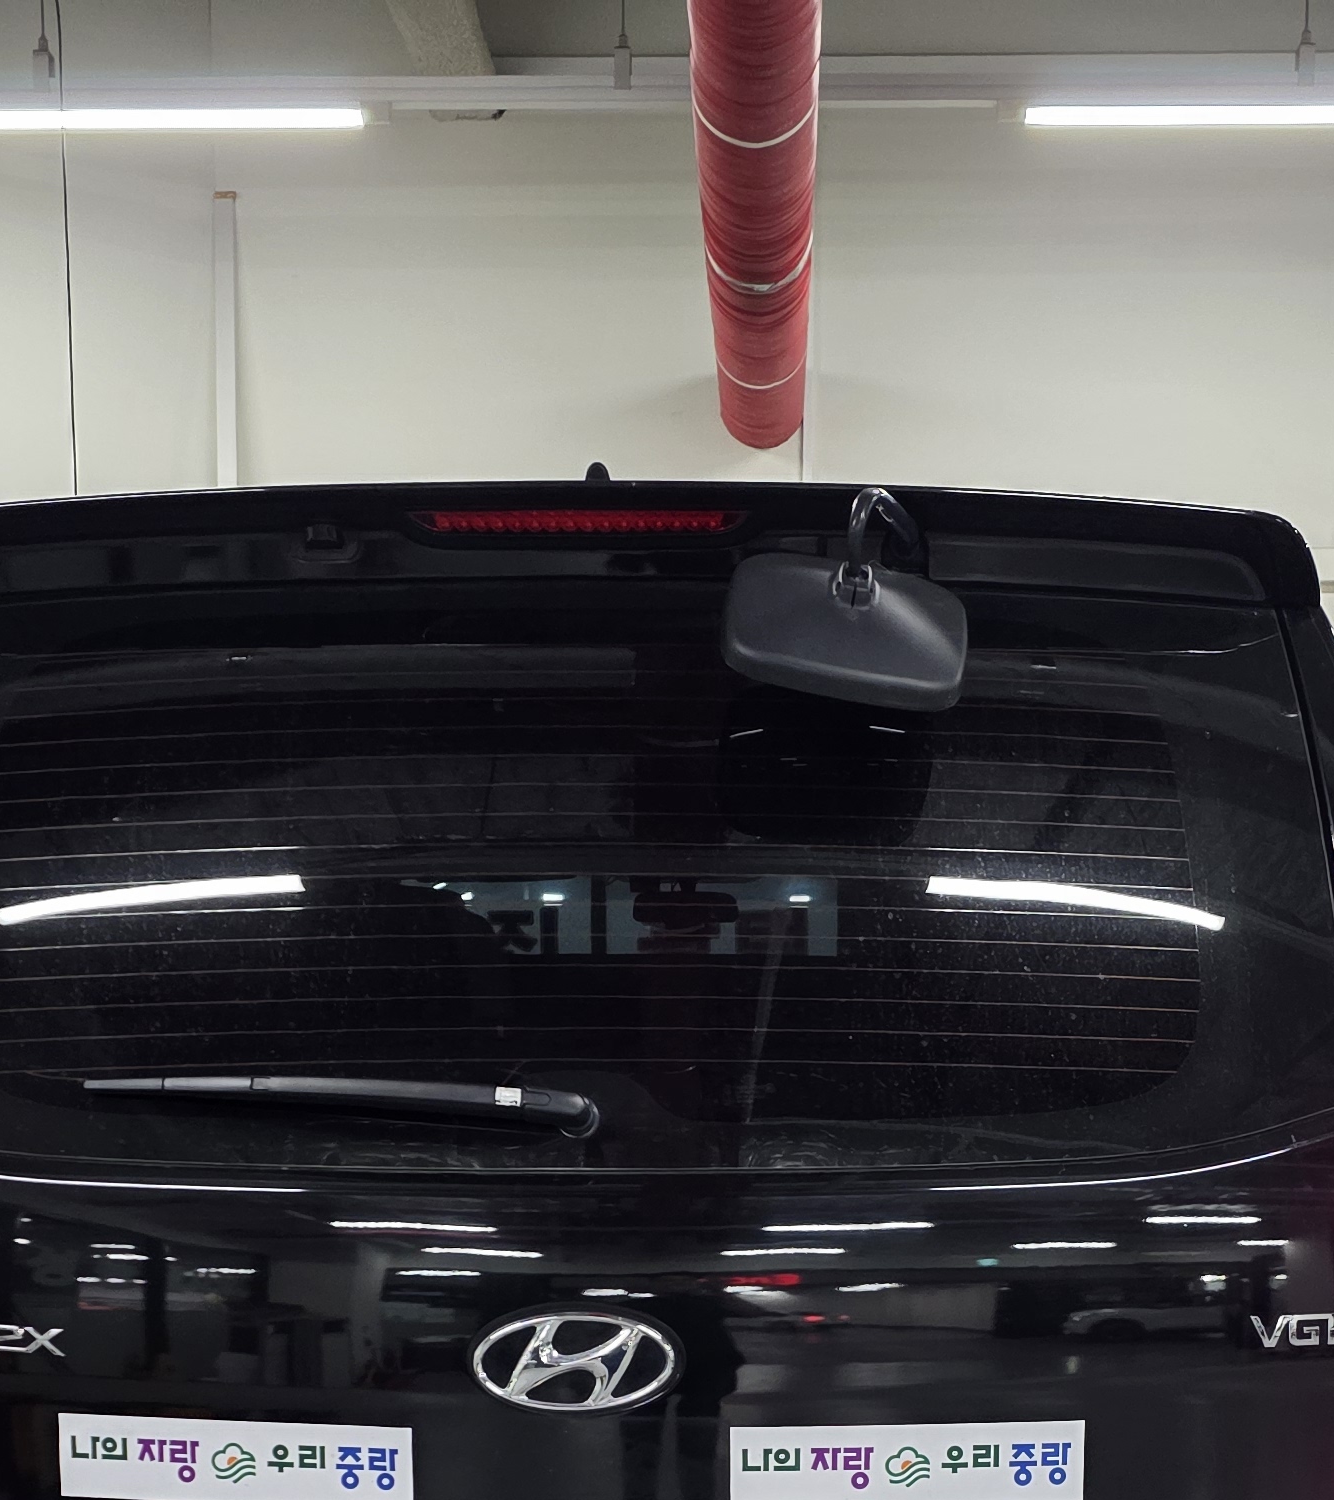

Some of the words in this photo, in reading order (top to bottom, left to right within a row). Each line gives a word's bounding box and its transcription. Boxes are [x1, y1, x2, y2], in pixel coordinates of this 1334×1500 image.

[71, 1435, 129, 1463] 나의
[137, 1438, 201, 1485] 자랑
[267, 1444, 328, 1474] 우리
[336, 1446, 400, 1492] 중랑
[741, 1447, 802, 1474] 나의
[810, 1446, 876, 1492] 자랑
[941, 1444, 1001, 1475] 우리
[1009, 1442, 1073, 1488] 중랑
